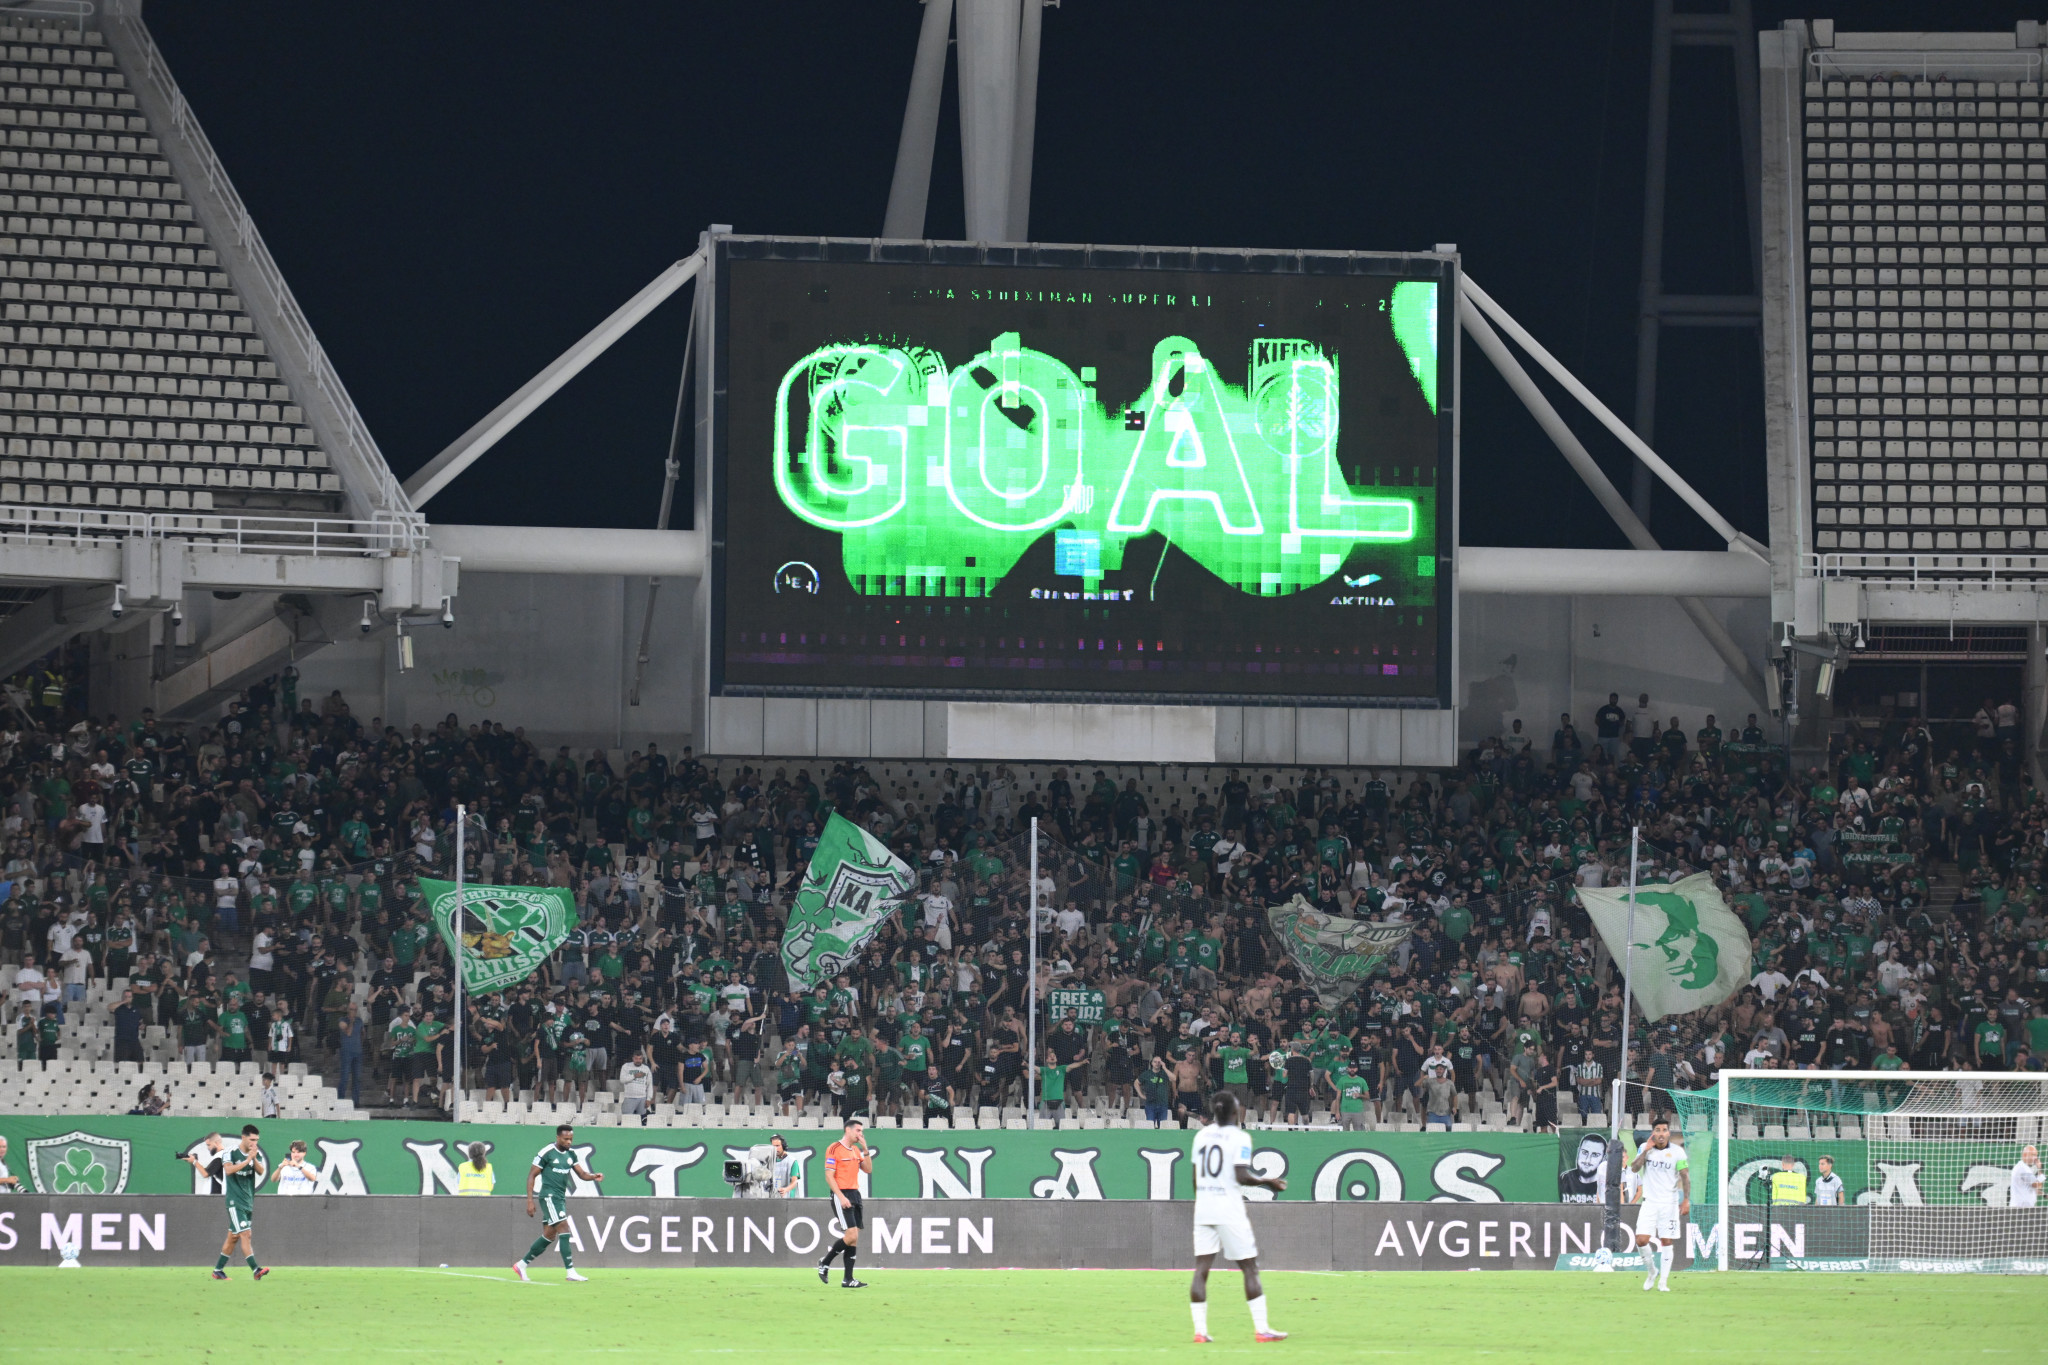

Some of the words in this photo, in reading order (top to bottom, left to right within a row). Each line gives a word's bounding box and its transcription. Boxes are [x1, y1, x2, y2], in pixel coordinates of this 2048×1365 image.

[774, 343, 1417, 538] GOAL
[436, 890, 542, 916] PANTHINAIKOS
[1051, 991, 1090, 1006] FREE
[1051, 1005, 1104, 1020] ΣΕΙΑΣ
[1198, 1144, 1223, 1178] 10
[40, 1212, 167, 1251] MEN
[871, 1216, 994, 1254] MEN
[1685, 1222, 1806, 1260] MEN
[1786, 1259, 1870, 1272] SUPERBET
